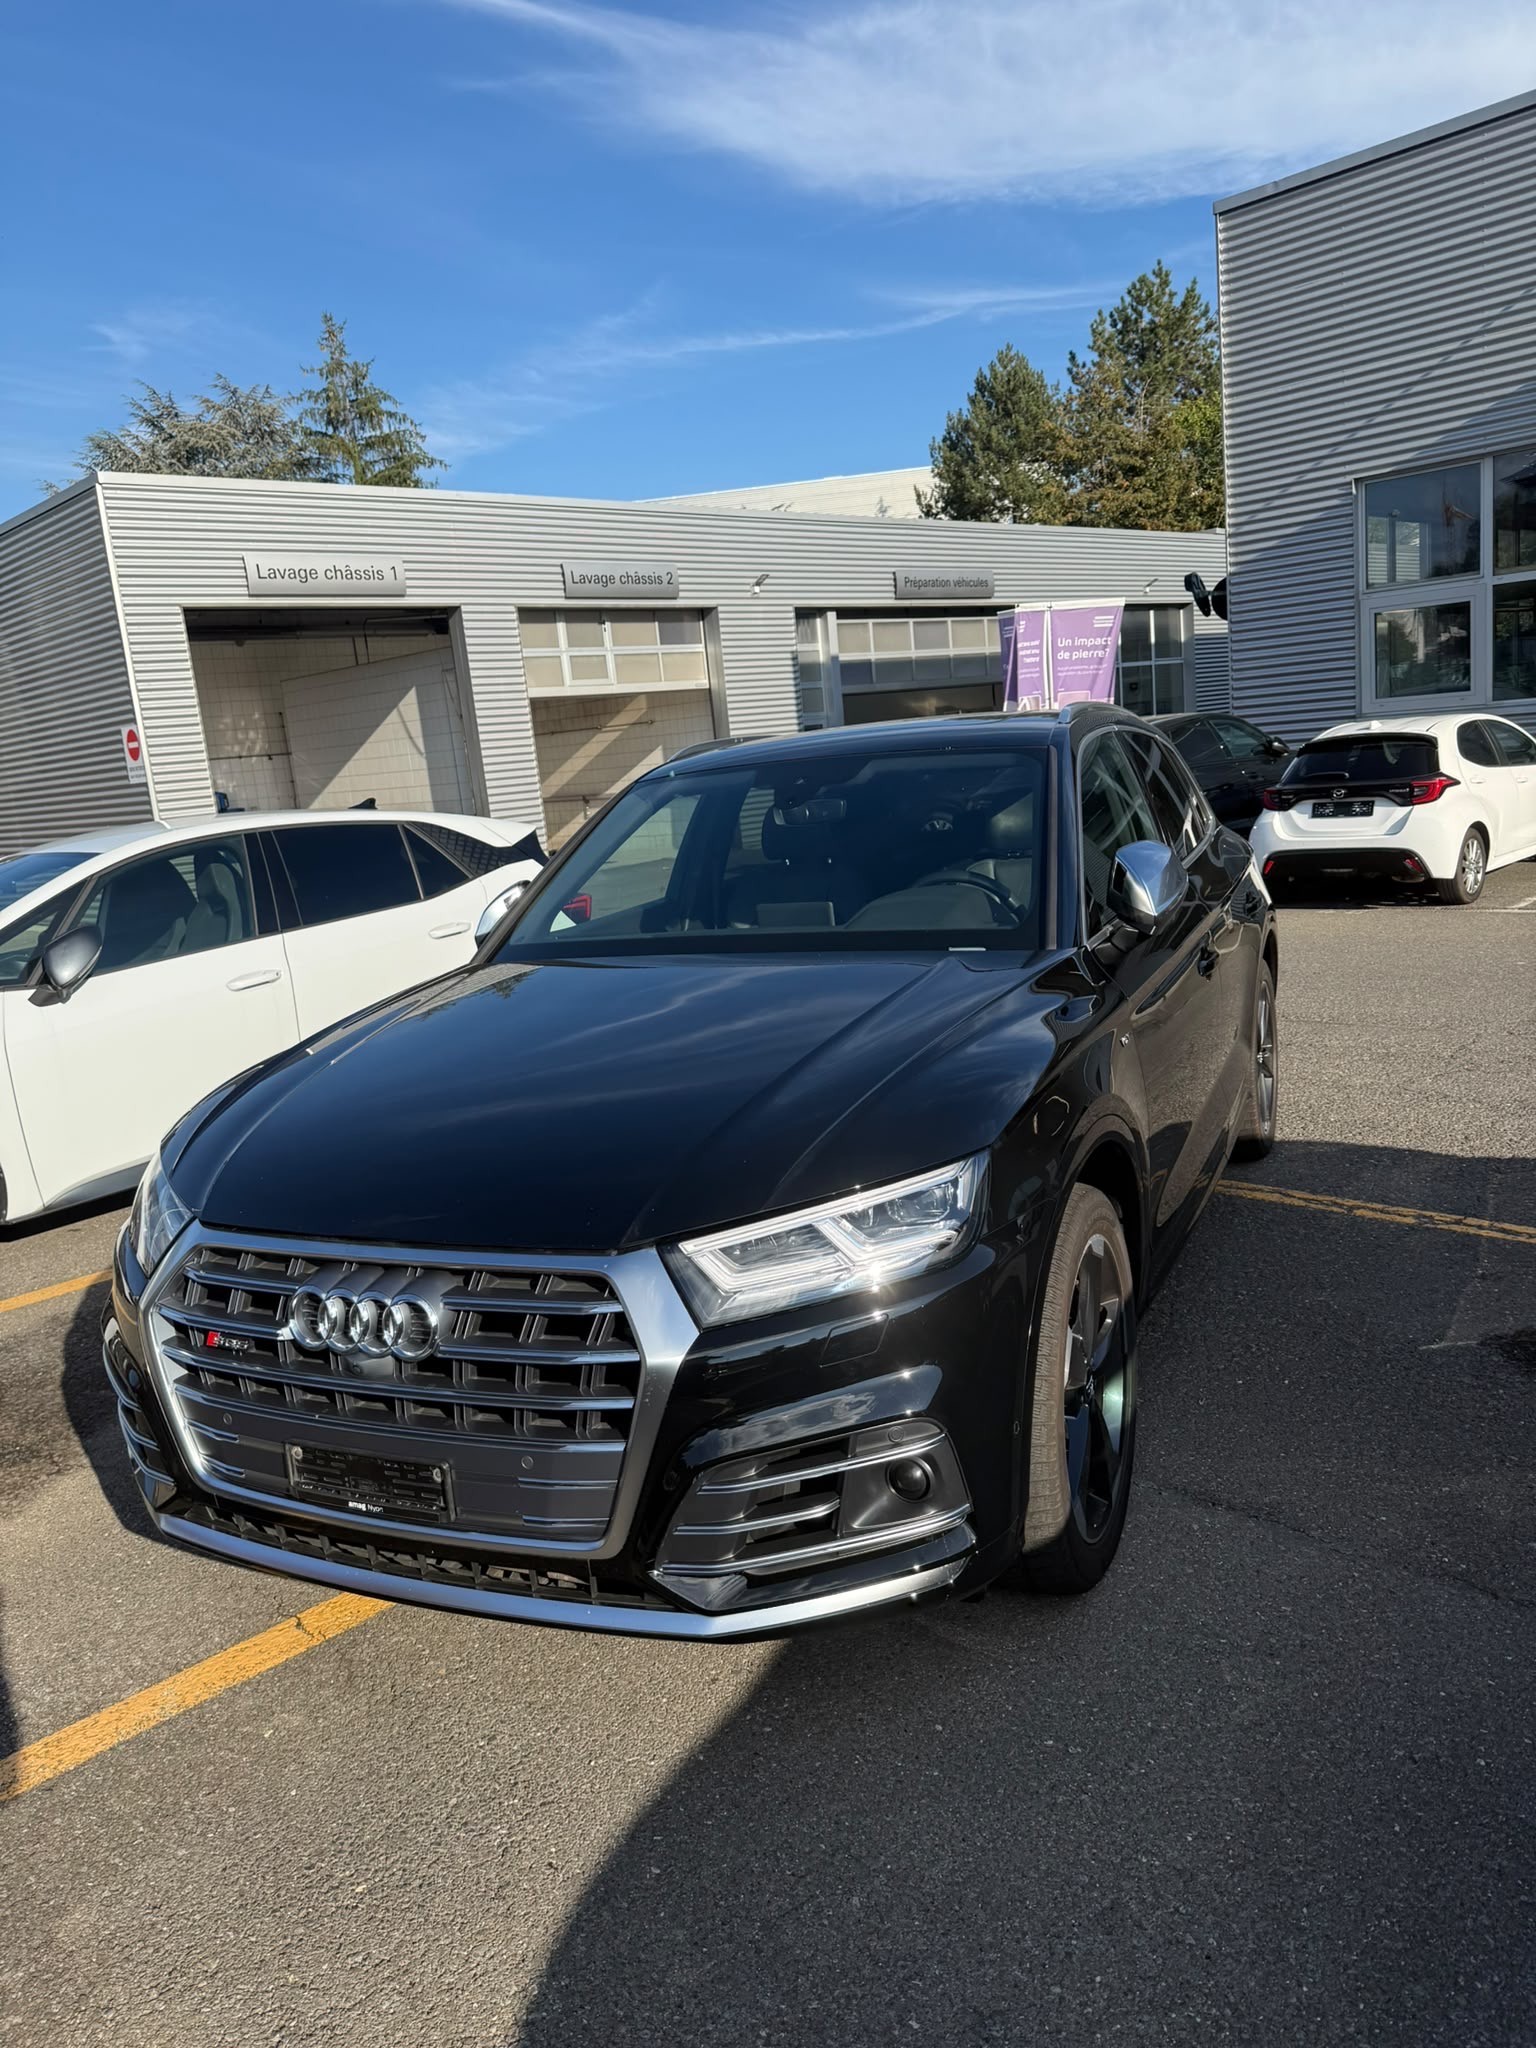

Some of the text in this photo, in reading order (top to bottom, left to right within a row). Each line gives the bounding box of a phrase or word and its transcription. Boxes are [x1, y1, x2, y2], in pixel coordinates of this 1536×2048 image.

[256, 563, 398, 584] Lavage châssis 1
[570, 570, 674, 588] Lavage châssis 2
[904, 576, 989, 590] Préparation véhicules
[1057, 636, 1112, 648] Un impact
[1057, 648, 1110, 661] de pierre?
[348, 1501, 367, 1511] amag
